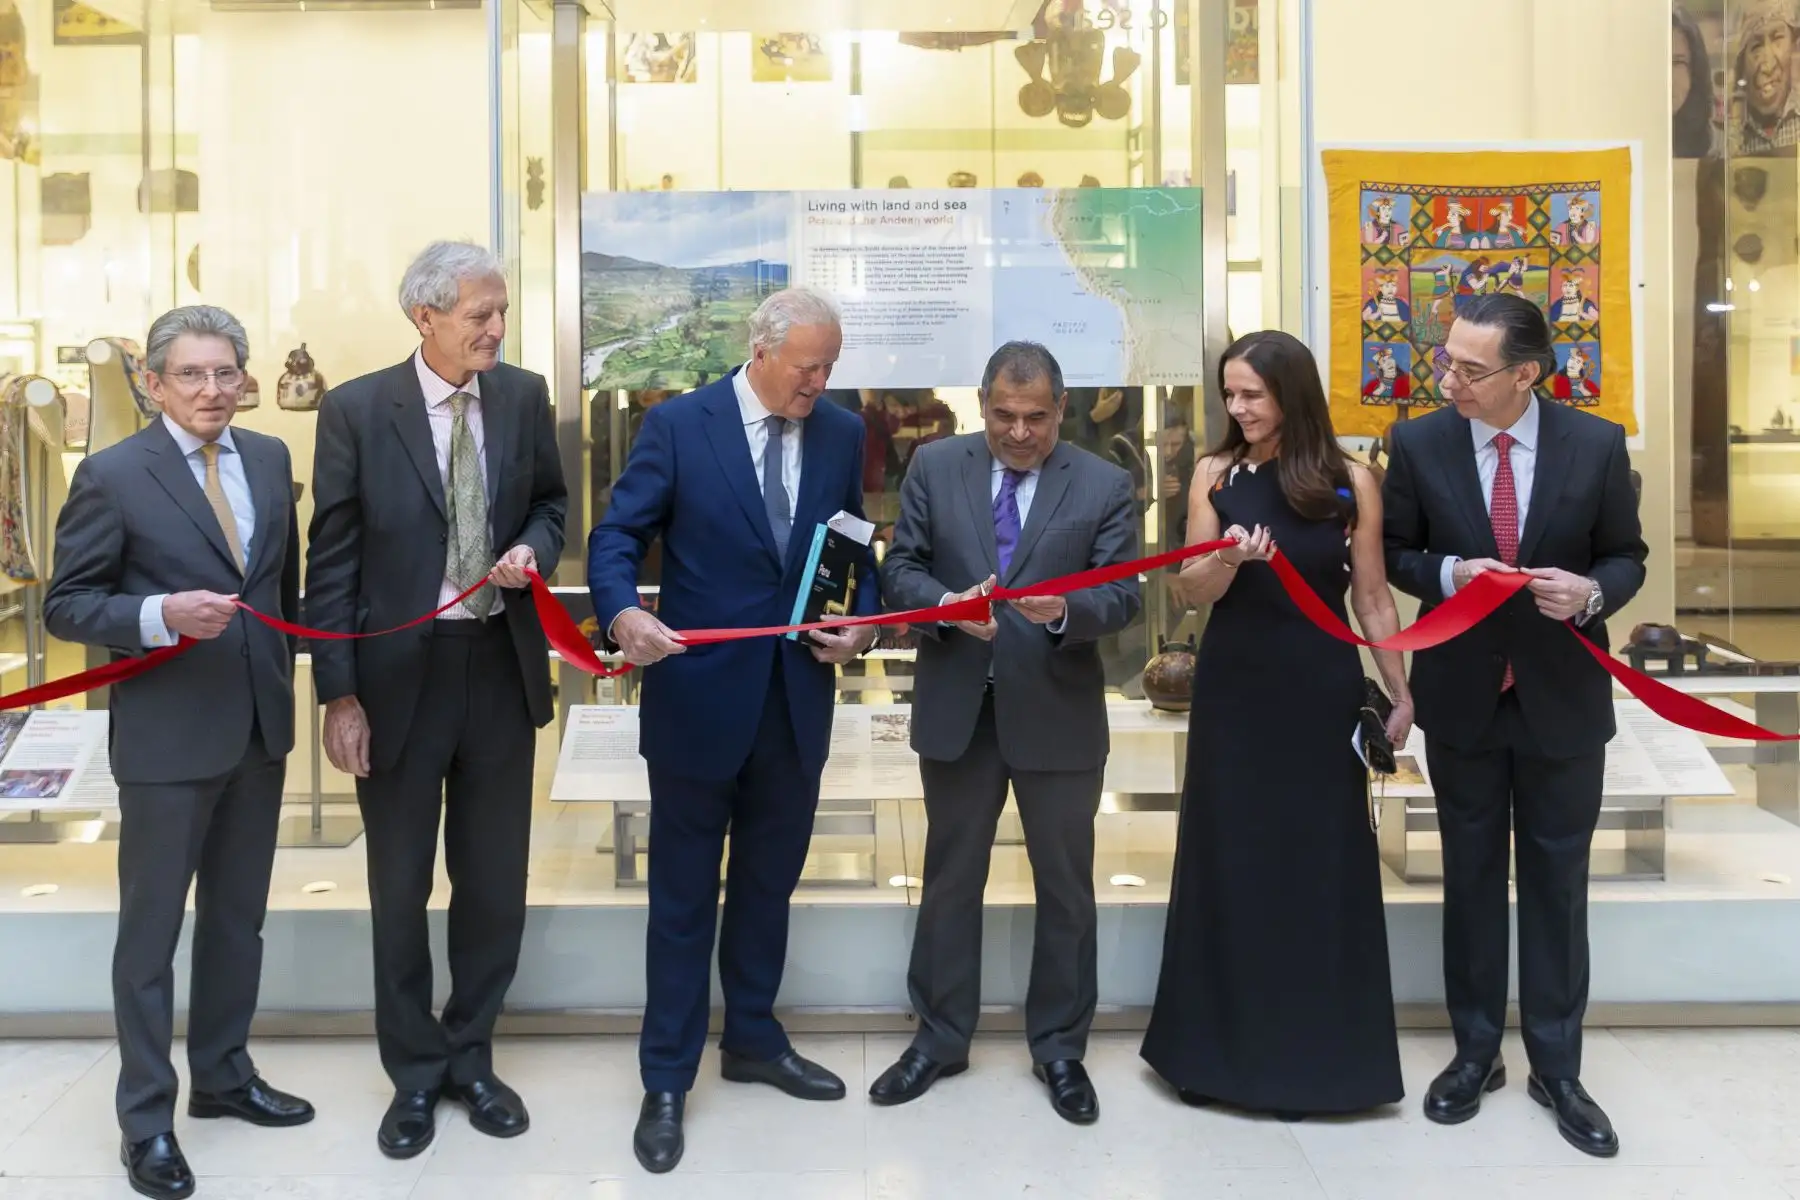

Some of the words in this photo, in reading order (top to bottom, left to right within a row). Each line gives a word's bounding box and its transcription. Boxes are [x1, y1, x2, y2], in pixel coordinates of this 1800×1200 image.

[808, 199, 846, 213] Living
[850, 199, 878, 211] with
[882, 198, 910, 211] land
[914, 199, 939, 211] and
[944, 201, 967, 210] sea
[923, 215, 954, 225] world
